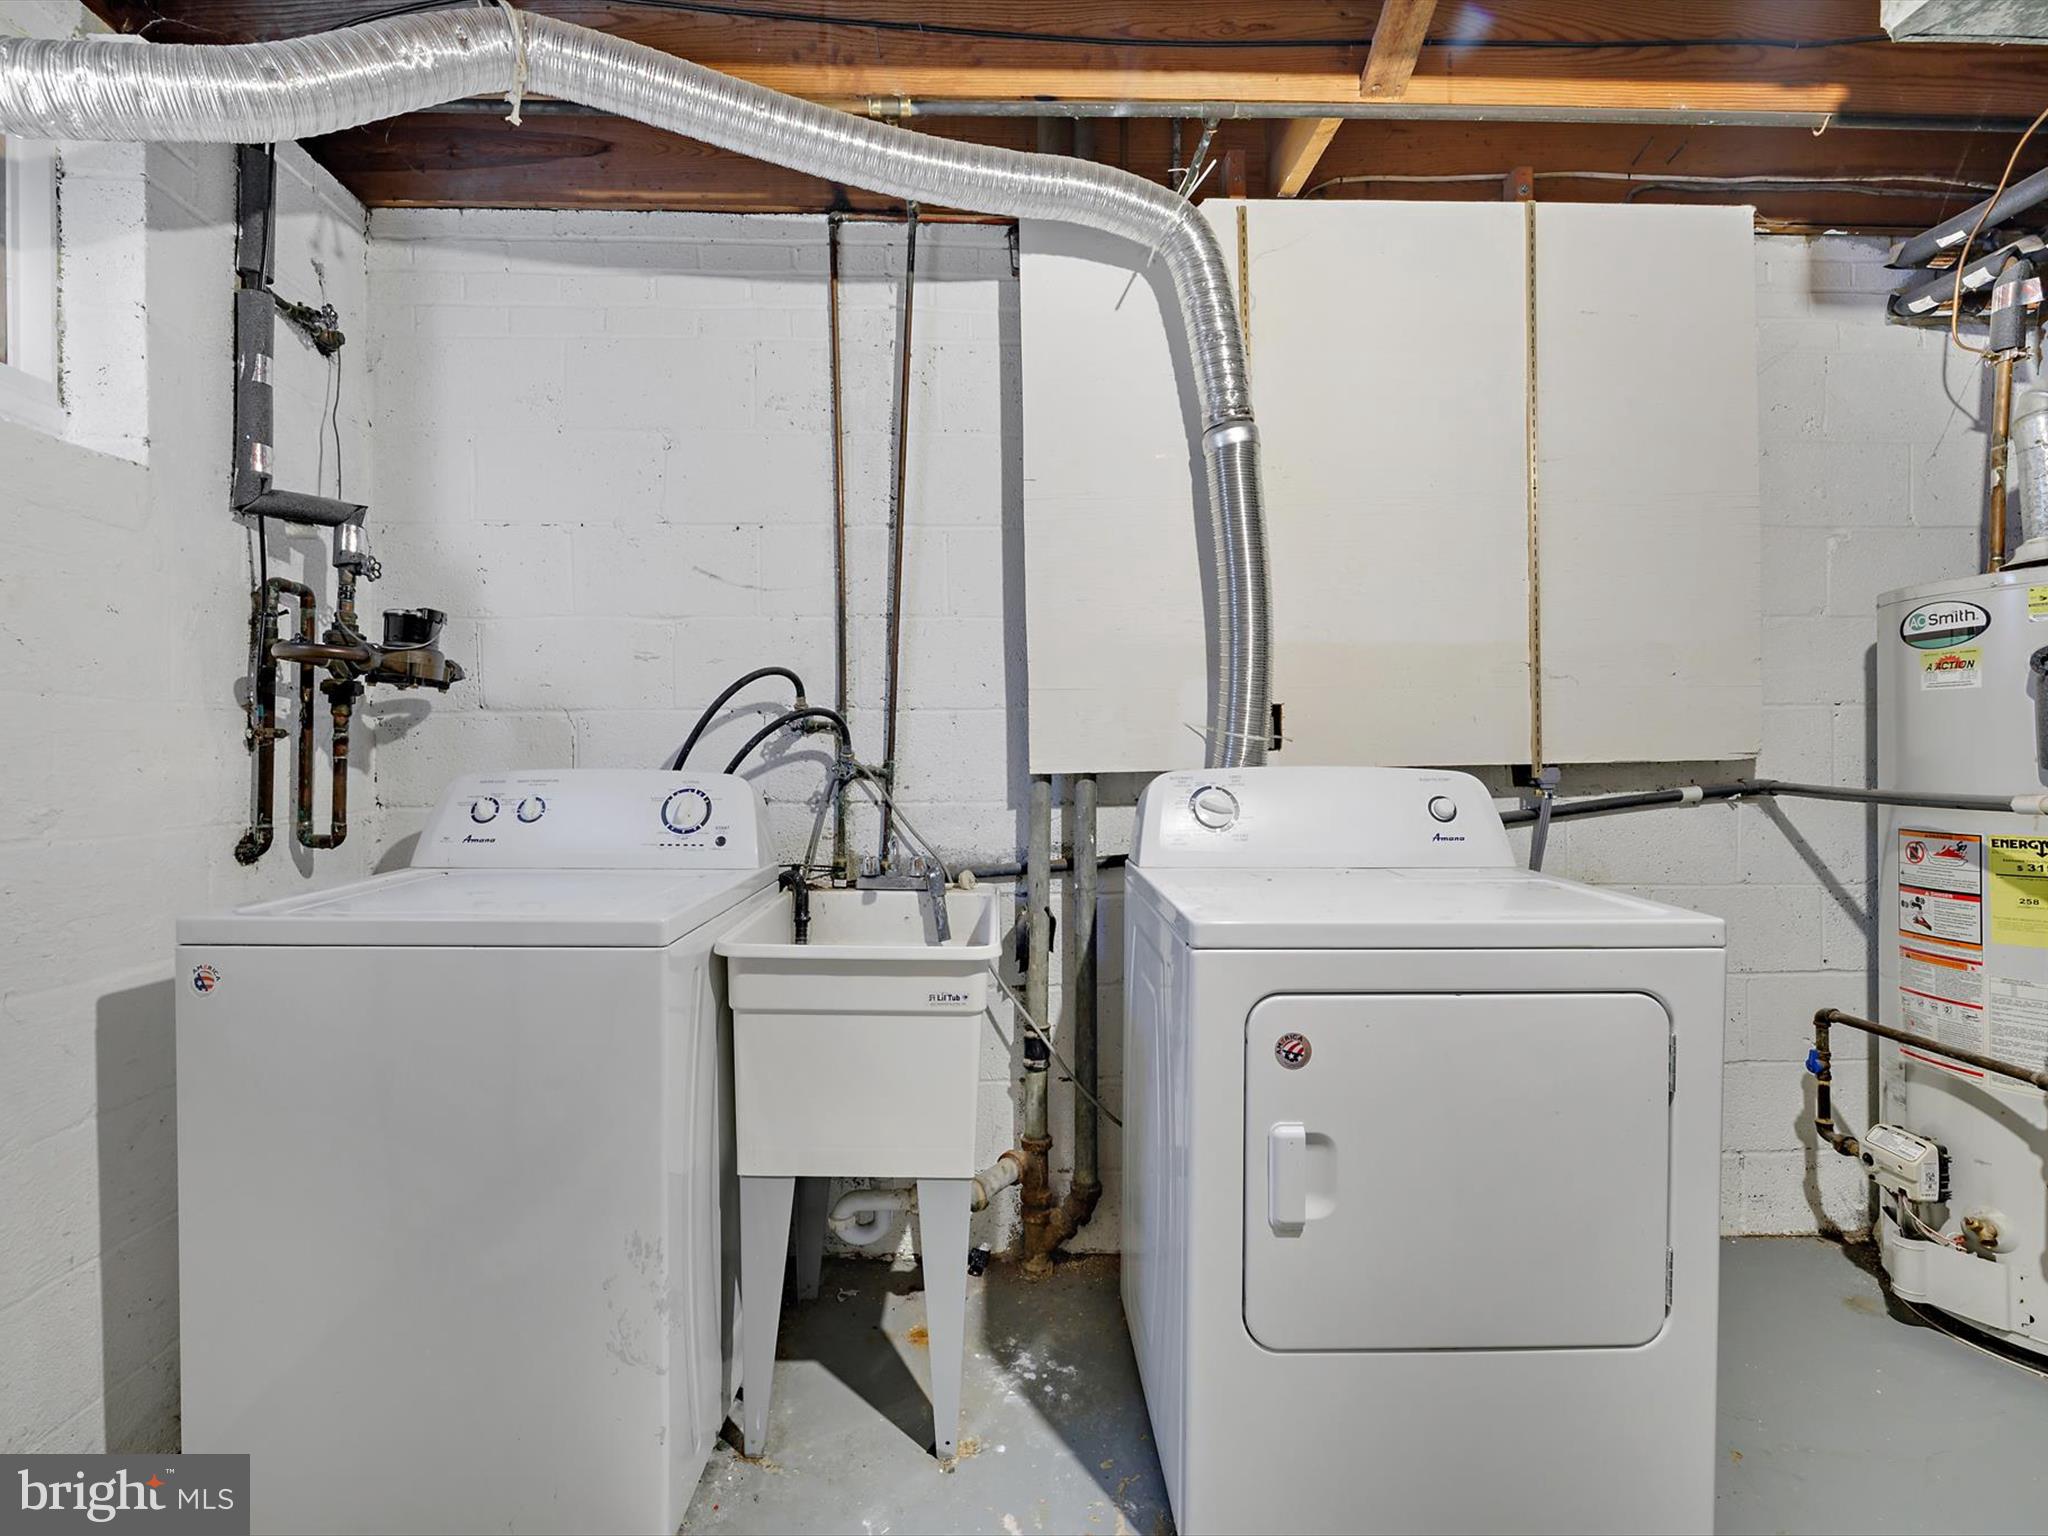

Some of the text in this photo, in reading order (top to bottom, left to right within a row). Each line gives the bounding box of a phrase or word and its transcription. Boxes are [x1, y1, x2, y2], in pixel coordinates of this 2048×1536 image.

[1928, 609, 1976, 626] Smith
[1934, 659, 1975, 671] ACTION
[462, 834, 496, 843] Amana
[1432, 832, 1465, 842] Amana
[1991, 838, 2048, 851] ENERGY
[2028, 863, 2048, 872] 31
